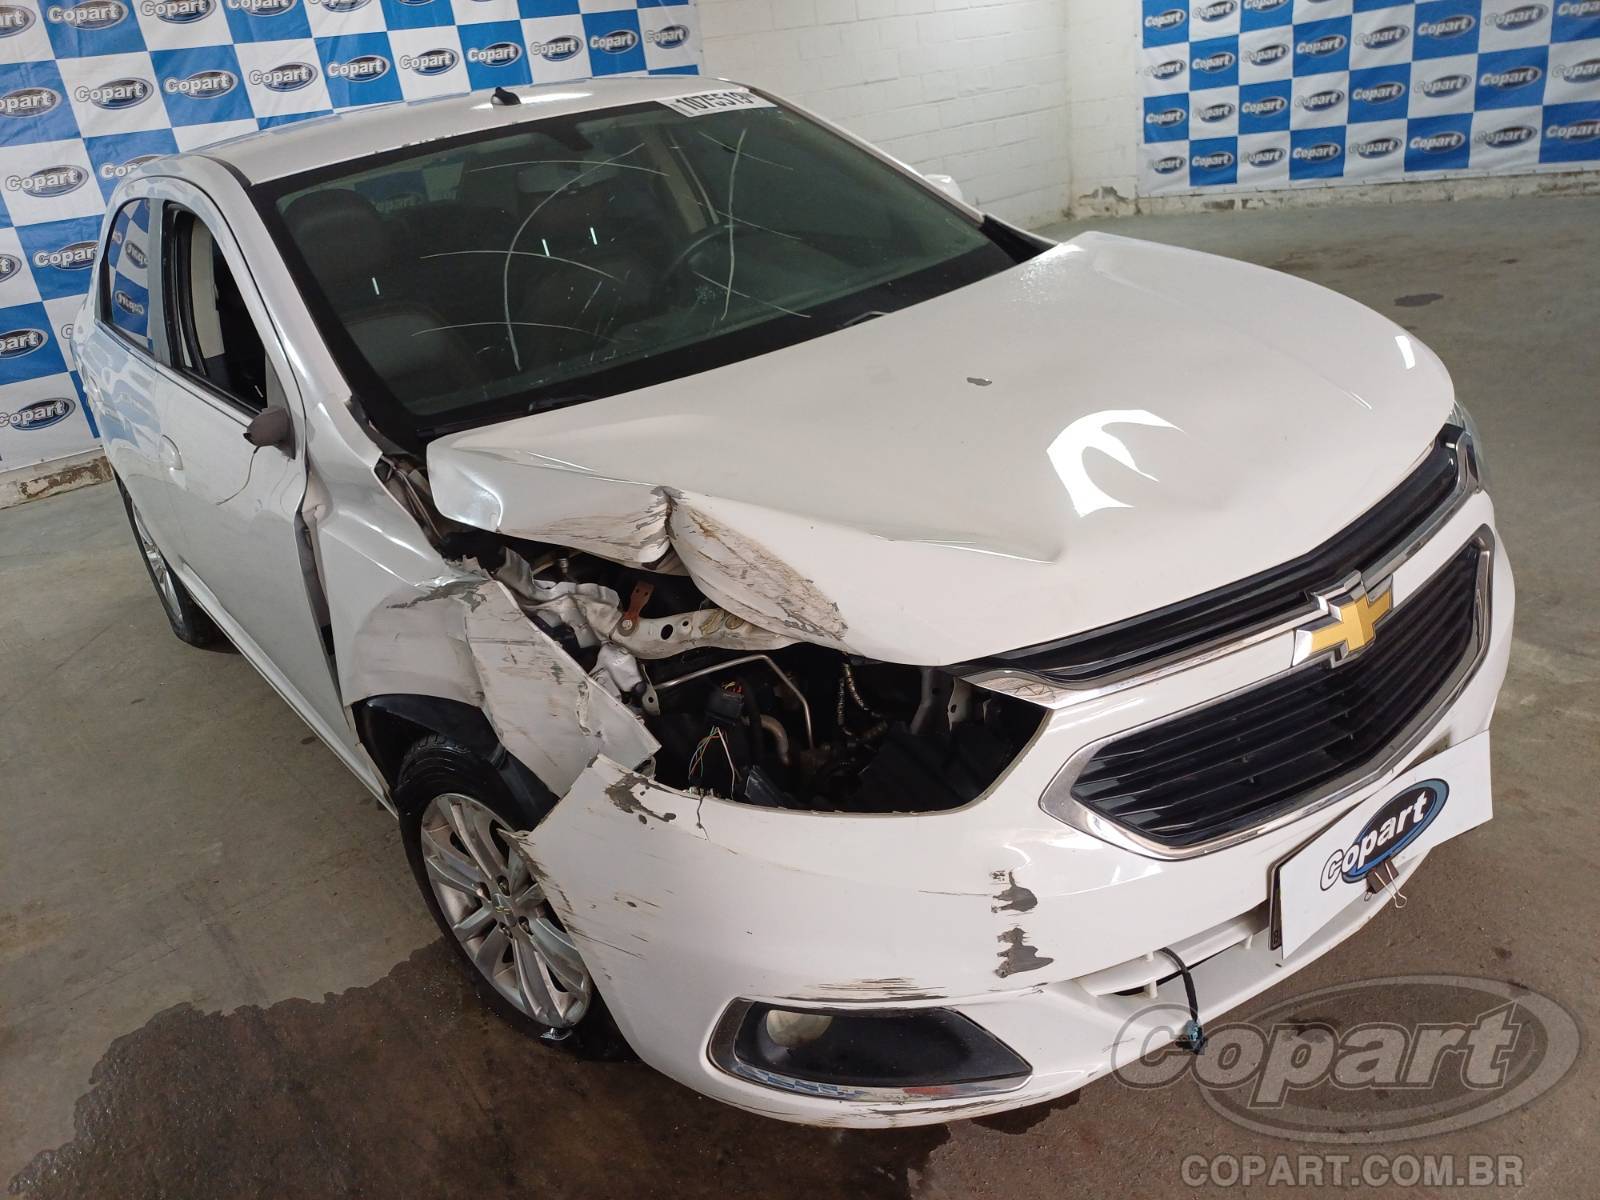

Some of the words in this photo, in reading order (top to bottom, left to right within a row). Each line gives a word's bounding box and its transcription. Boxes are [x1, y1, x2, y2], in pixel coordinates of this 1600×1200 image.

[48, 3, 117, 26] Copart
[142, 0, 206, 19] Copart
[1485, 8, 1537, 26] Copart
[1557, 2, 1600, 17] Copa
[1145, 12, 1181, 28] Copart
[1418, 18, 1467, 36] Copart
[590, 31, 633, 51] Copart
[646, 27, 684, 44] Copart
[468, 45, 515, 65] Copart
[531, 38, 577, 59] Copart
[1296, 38, 1340, 54] Copart
[327, 58, 383, 79] Copart
[400, 51, 452, 72] Copart
[1192, 56, 1230, 70] Copart
[1552, 63, 1600, 78] Copar
[163, 73, 229, 95] Copart
[250, 66, 309, 86] Copart
[1479, 69, 1534, 87] Copart
[0, 91, 51, 113] part
[74, 81, 144, 104] Copart
[1353, 86, 1398, 100] Copart
[1242, 99, 1281, 114] Copart
[1409, 134, 1458, 150] Copart
[1192, 154, 1229, 168] Copart
[1293, 146, 1336, 160] Copart
[6, 169, 78, 192] Copart
[34, 246, 99, 267] Copar
[0, 331, 38, 356] part
[1320, 790, 1427, 891] Copart
